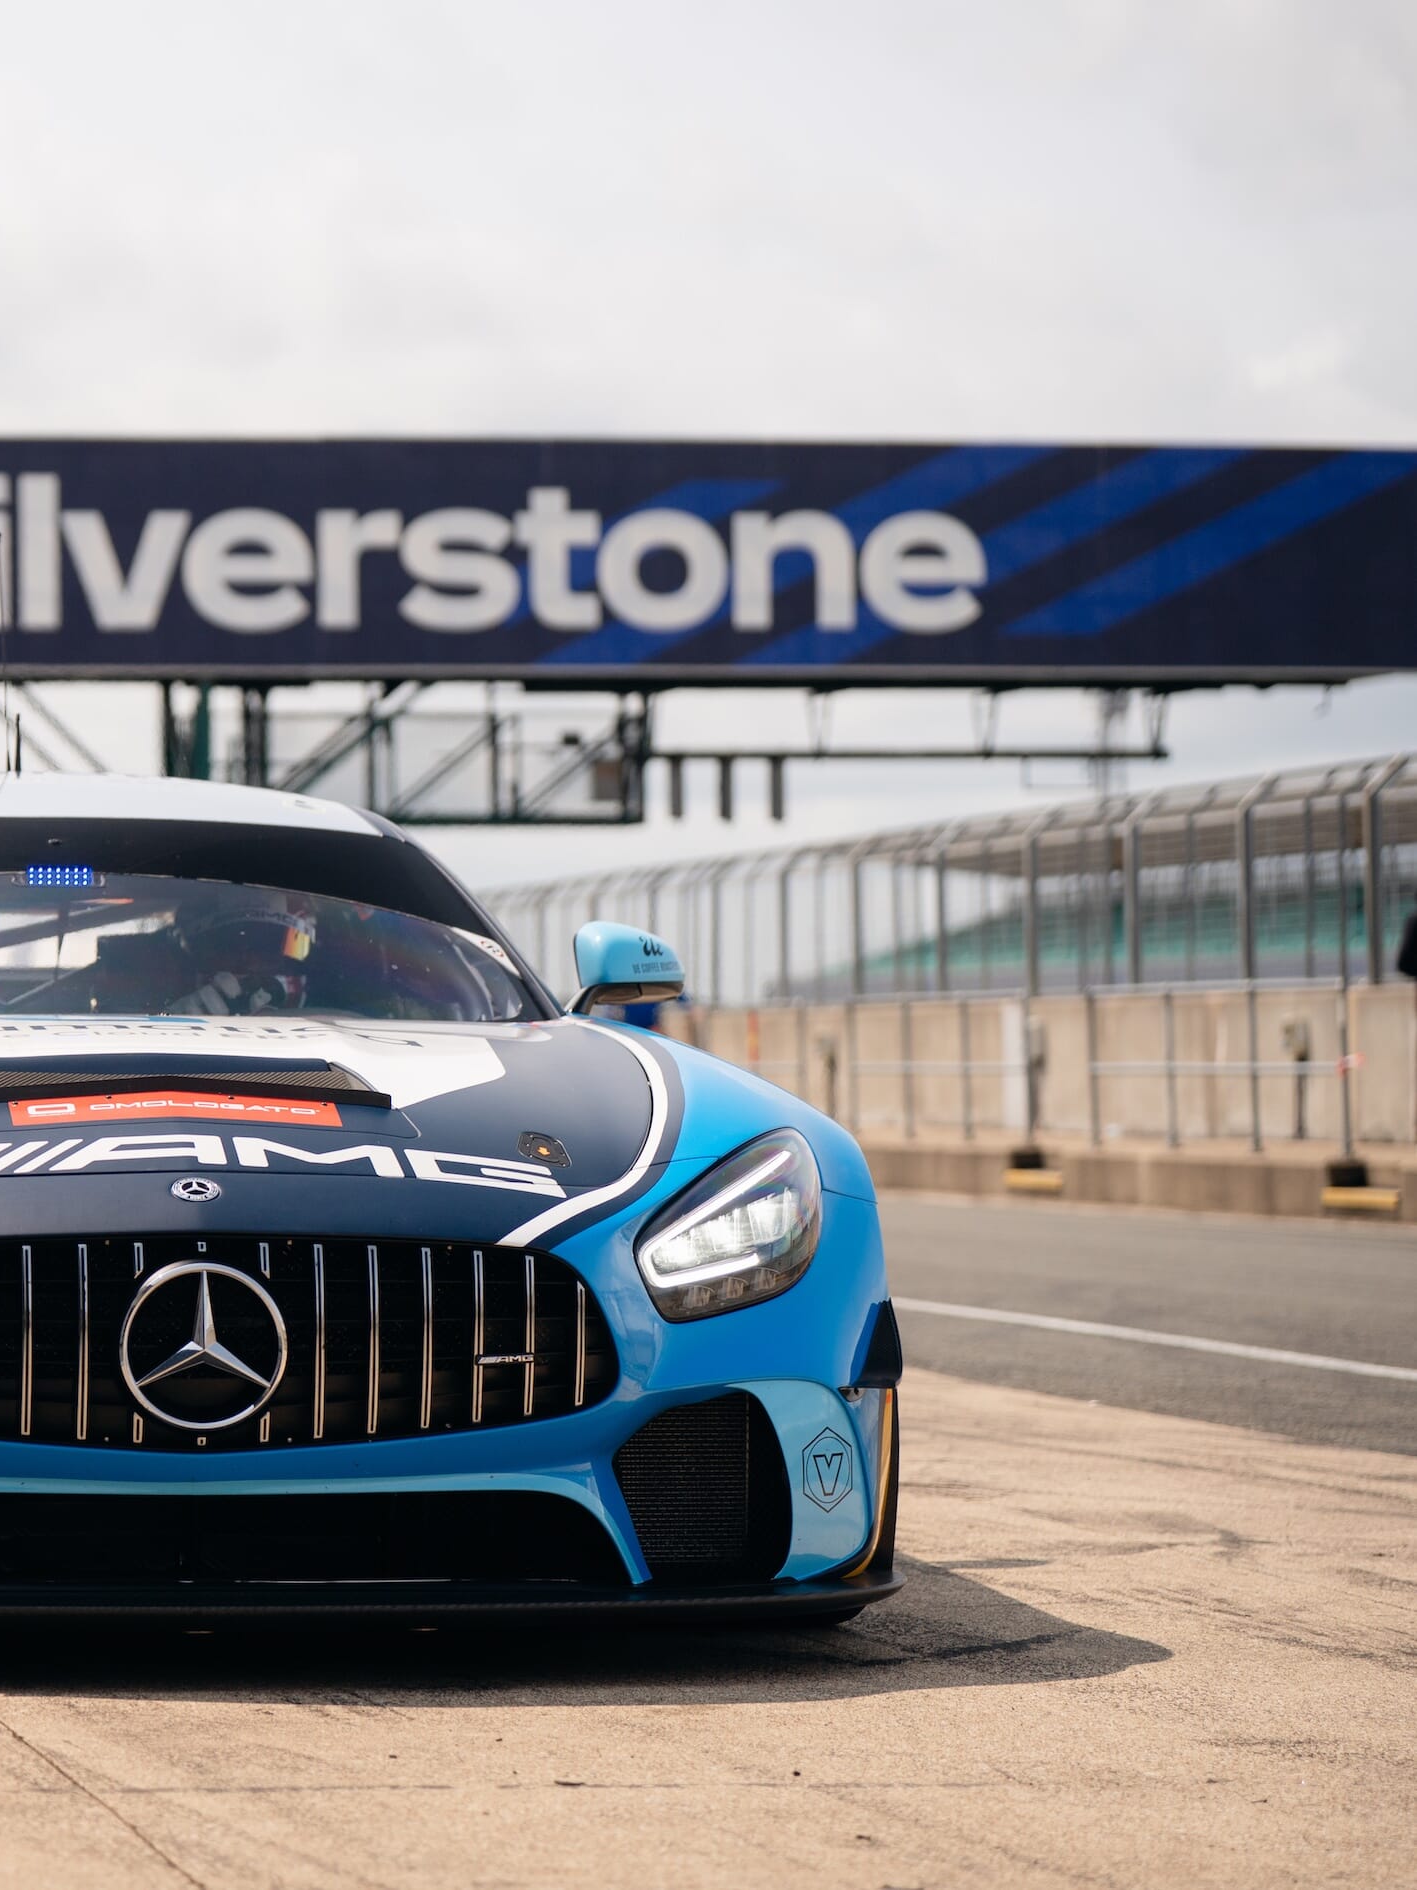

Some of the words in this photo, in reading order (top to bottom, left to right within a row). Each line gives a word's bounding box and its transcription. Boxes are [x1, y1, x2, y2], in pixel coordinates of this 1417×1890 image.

[89, 1099, 317, 1116] OMOLOGATO
[49, 1135, 567, 1198] AMG
[495, 1354, 535, 1363] AMG
